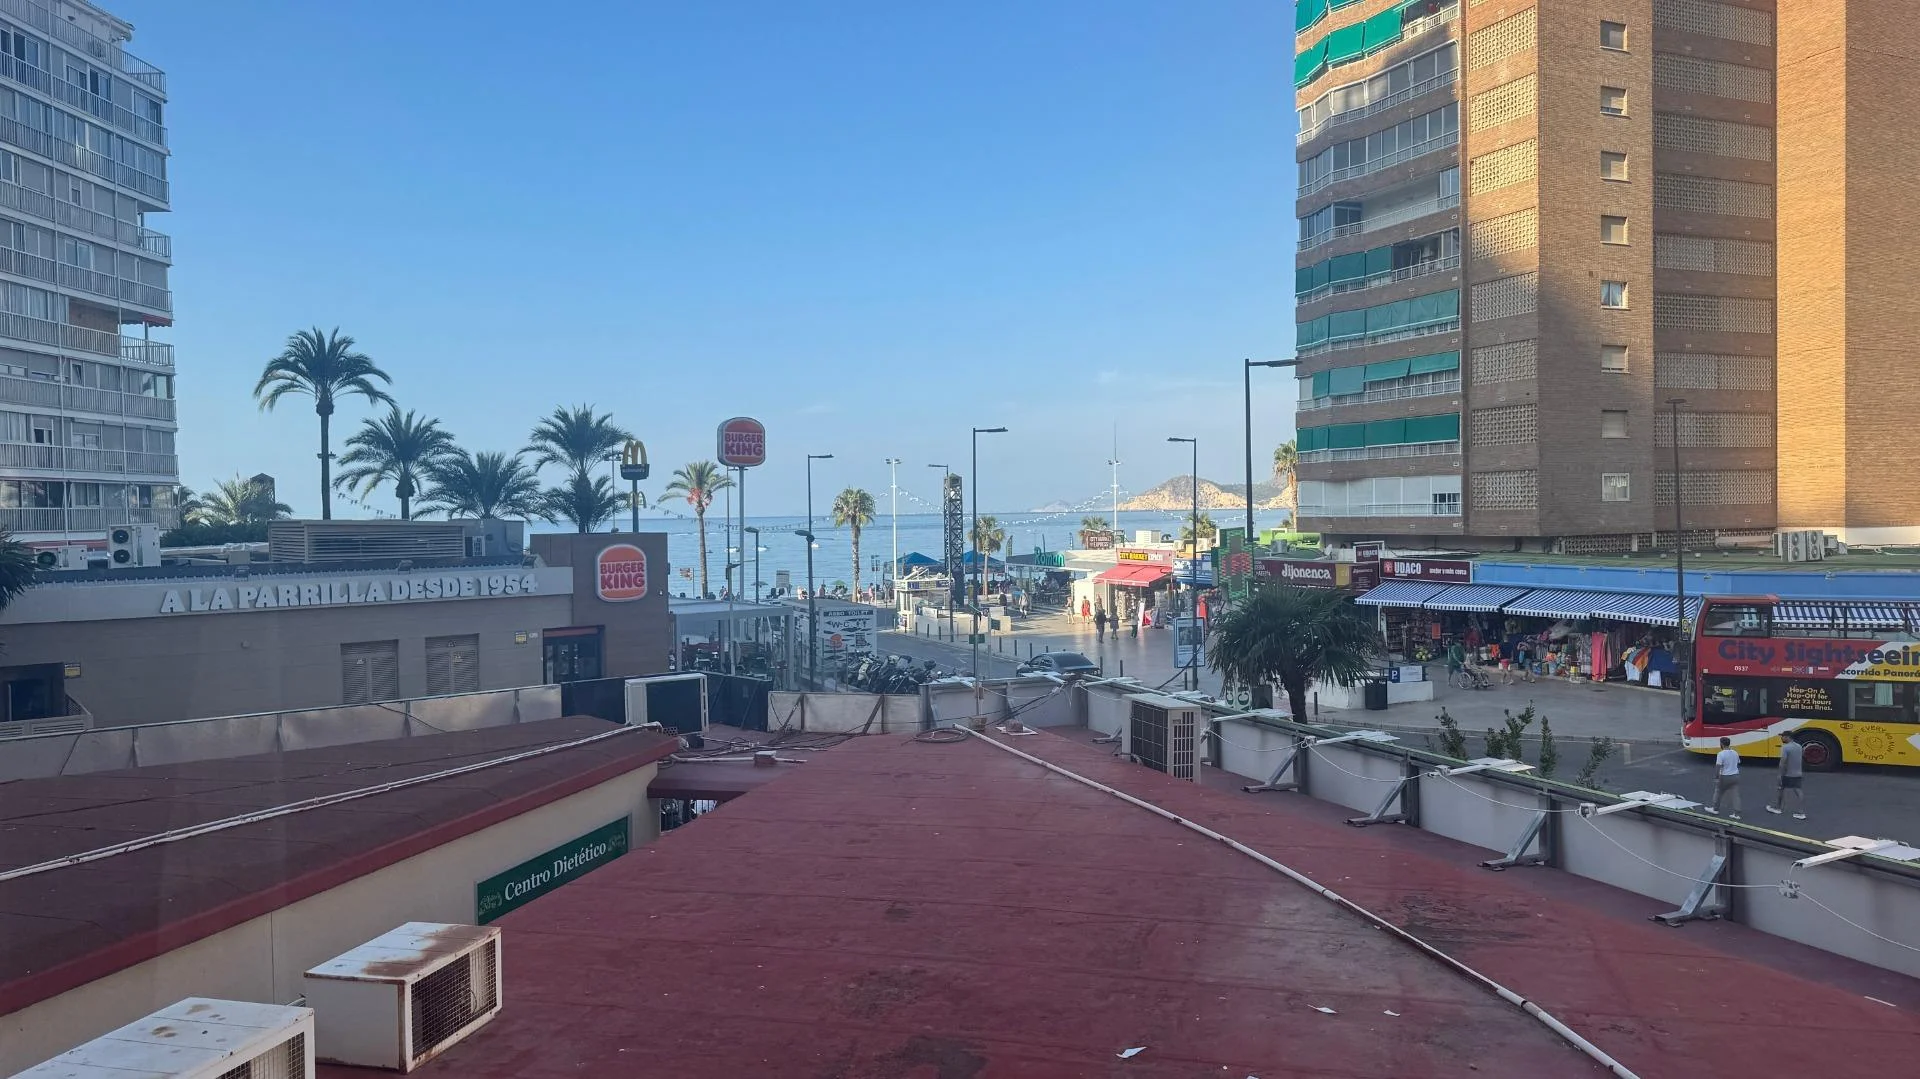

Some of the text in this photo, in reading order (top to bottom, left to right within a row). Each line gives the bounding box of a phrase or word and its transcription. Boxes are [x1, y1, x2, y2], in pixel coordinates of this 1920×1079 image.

[725, 432, 763, 444] BURGER
[725, 443, 763, 456] KING
[1034, 546, 1065, 567] Roman
[600, 562, 645, 574] BURGER
[1281, 563, 1332, 580] Jijonenca
[1394, 561, 1421, 575] UDACO
[600, 573, 645, 590] KING
[160, 573, 537, 613] A LA PARRILLA DESDE 1954
[1718, 639, 1775, 665] City
[1391, 670, 1398, 680] P
[1789, 686, 1818, 695] Hop-On
[1861, 725, 1886, 733] EVERY
[504, 842, 607, 901] Centro Dietético
